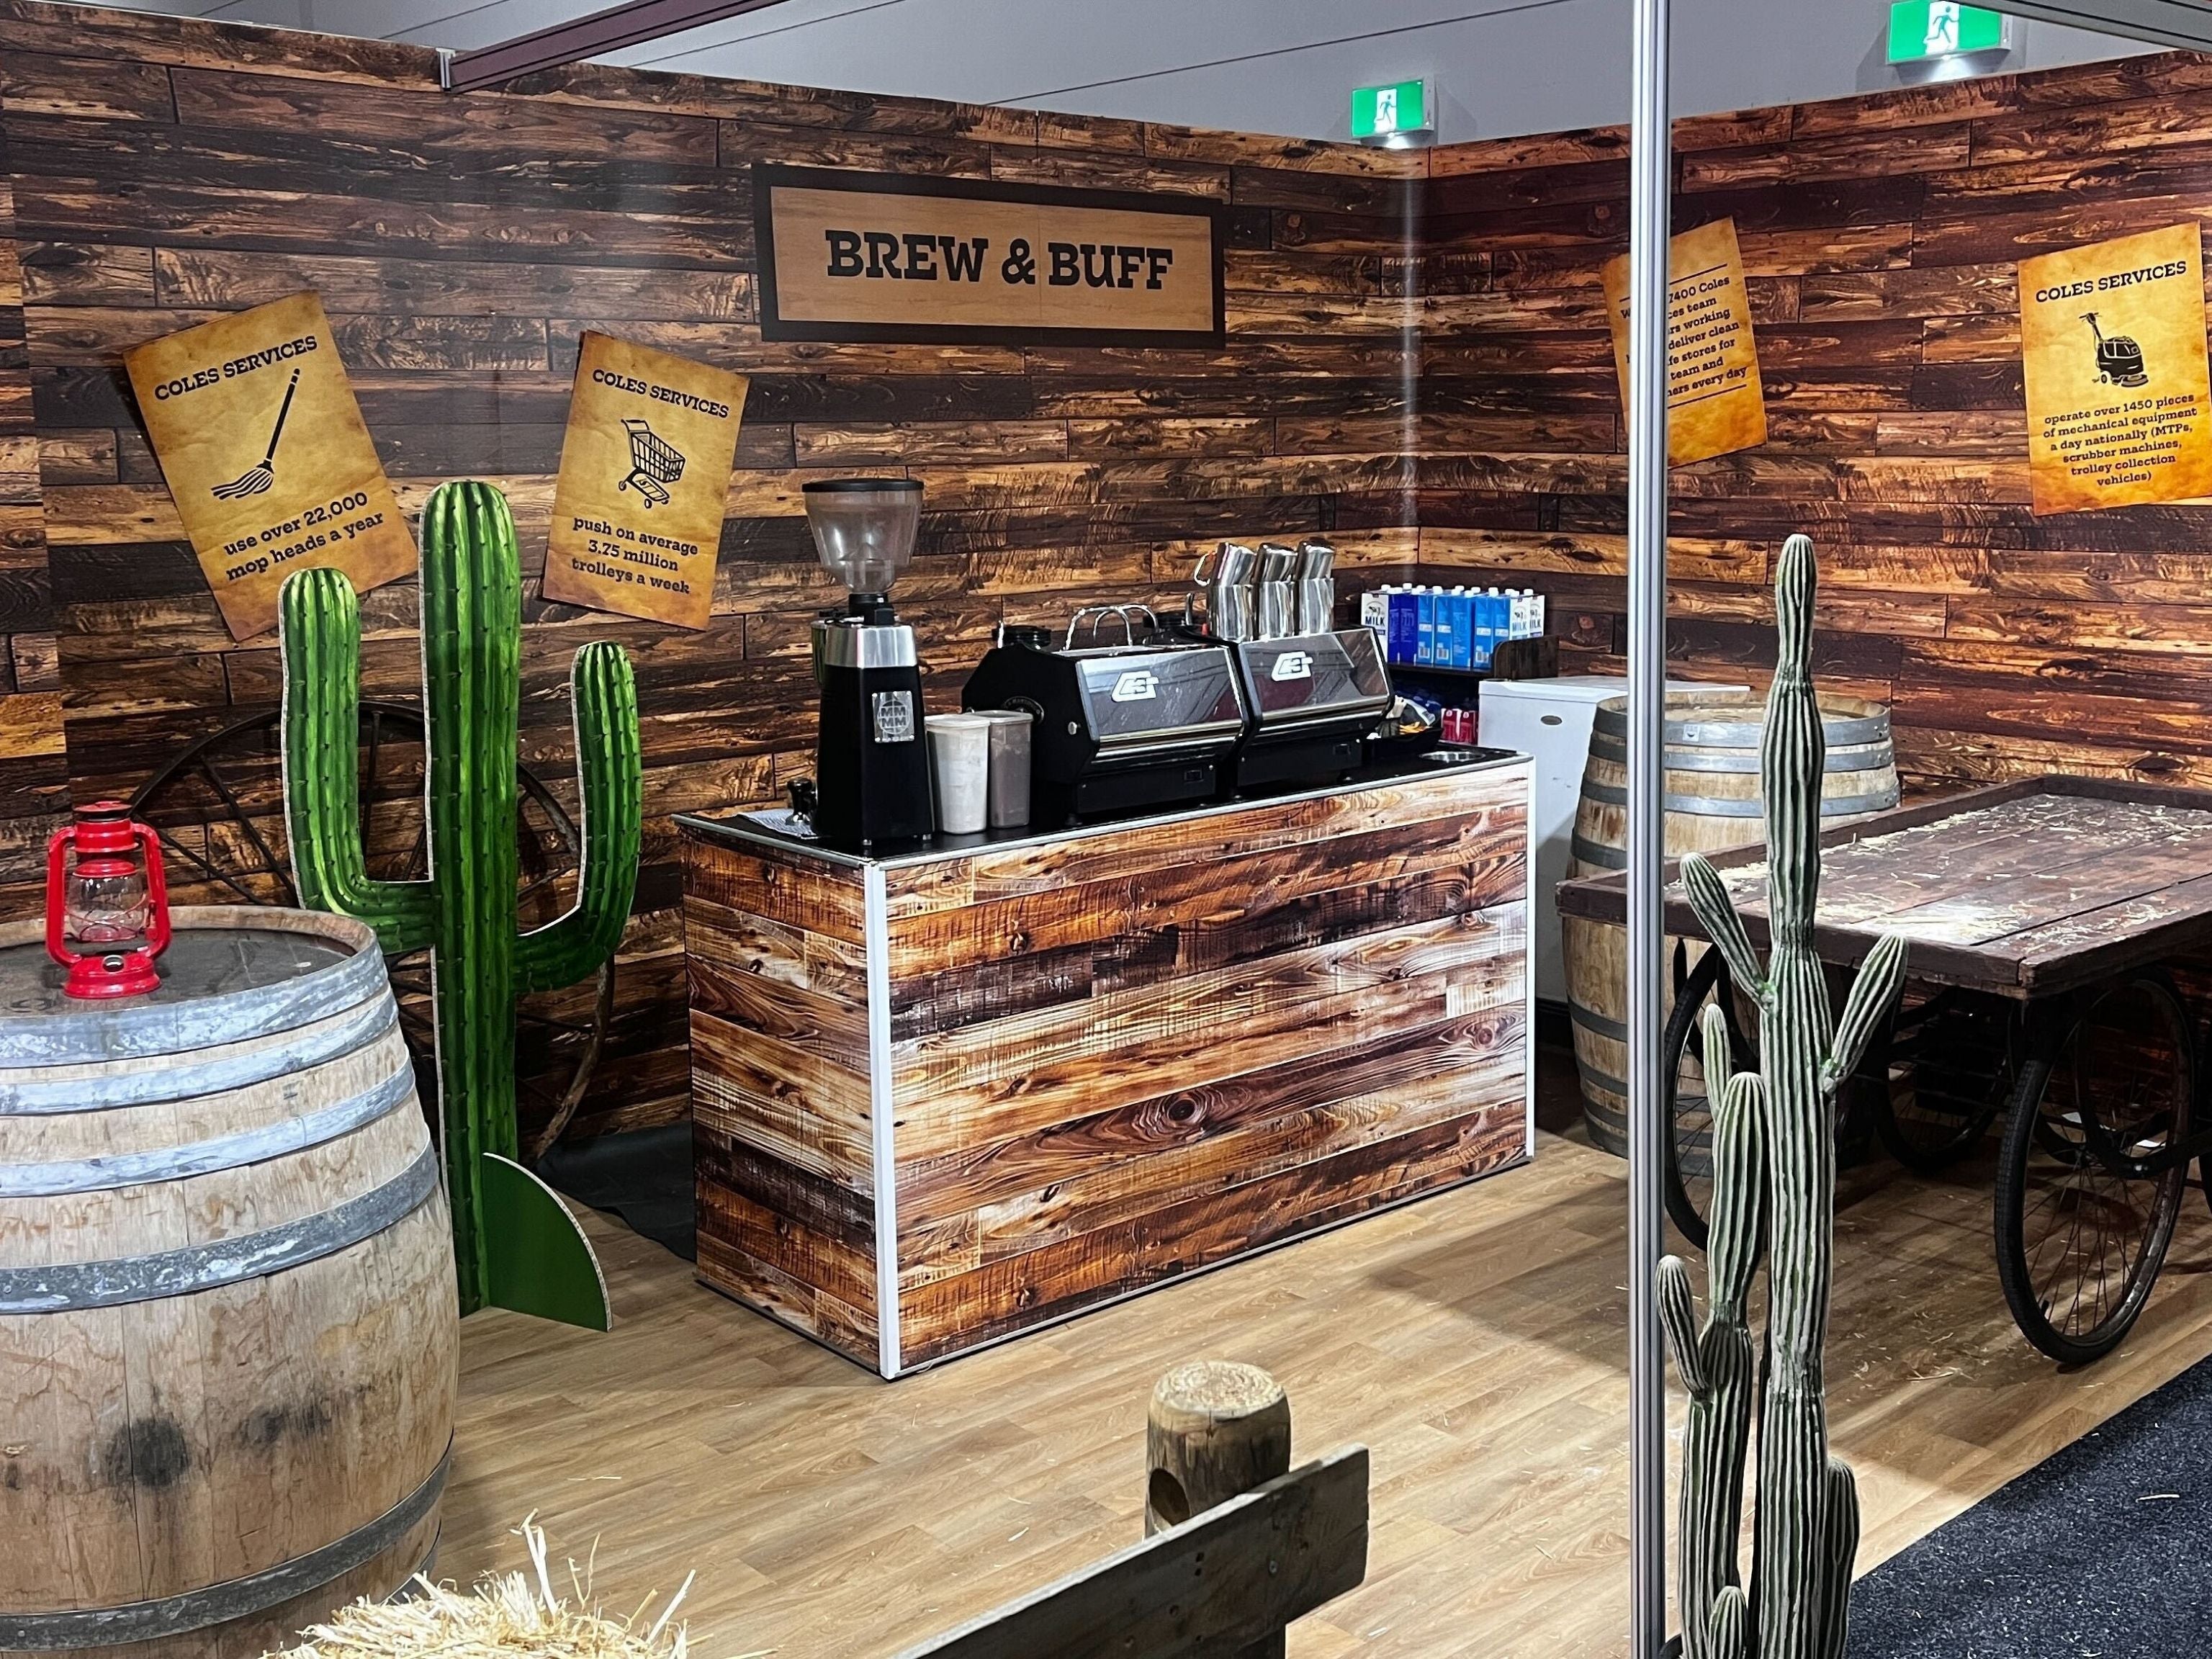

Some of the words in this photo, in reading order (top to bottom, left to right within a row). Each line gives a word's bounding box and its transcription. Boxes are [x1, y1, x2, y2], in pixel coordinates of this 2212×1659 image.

[825, 228, 989, 282] BREW
[1002, 238, 1035, 285] &
[1048, 242, 1173, 289] BUFF
[1699, 276, 1730, 292] Coles
[2036, 280, 2093, 302] COLES
[2098, 261, 2186, 290] SERVICES
[1683, 308, 1731, 330] working
[1686, 297, 1717, 313] team
[1668, 331, 1707, 350] deliver
[1709, 322, 1740, 337] clean
[1681, 345, 1717, 361] stores
[1719, 338, 1736, 350] for
[155, 368, 220, 400] COLES
[223, 336, 318, 378] SERVICES
[1670, 365, 1700, 380] team
[1702, 356, 1724, 371] and
[1692, 374, 1724, 389] every
[1726, 367, 1748, 379] day
[593, 369, 647, 395] COLES
[649, 385, 729, 418] SERVICES
[2043, 427, 2055, 438] of
[2058, 417, 2128, 436] mechanical
[2131, 407, 2198, 426] equipment
[2044, 410, 2091, 426] operate
[2094, 405, 2121, 417] over
[2123, 399, 2153, 413] 1450
[2156, 394, 2195, 410] pieces
[2060, 439, 2082, 450] day
[2085, 429, 2148, 446] nationally
[2150, 423, 2193, 437] (MTPs,
[2063, 448, 2117, 463] scrubber
[2119, 439, 2182, 455] machines,
[2071, 463, 2113, 476] trolley
[2115, 454, 2176, 469] collection
[2096, 469, 2152, 486] vehicles)
[223, 536, 258, 555] use
[261, 518, 301, 542] over
[303, 492, 368, 526] 22,000
[572, 517, 612, 536] push
[616, 528, 635, 541] on
[639, 533, 698, 557] average
[225, 556, 269, 580] mop
[269, 534, 326, 563] heads
[329, 529, 342, 541] a
[343, 513, 384, 539] year
[588, 539, 621, 557] 3.75
[623, 550, 678, 572] million
[572, 557, 633, 583] trolleys
[637, 573, 646, 585] a
[649, 576, 691, 594] week
[1365, 616, 1385, 626] MILK
